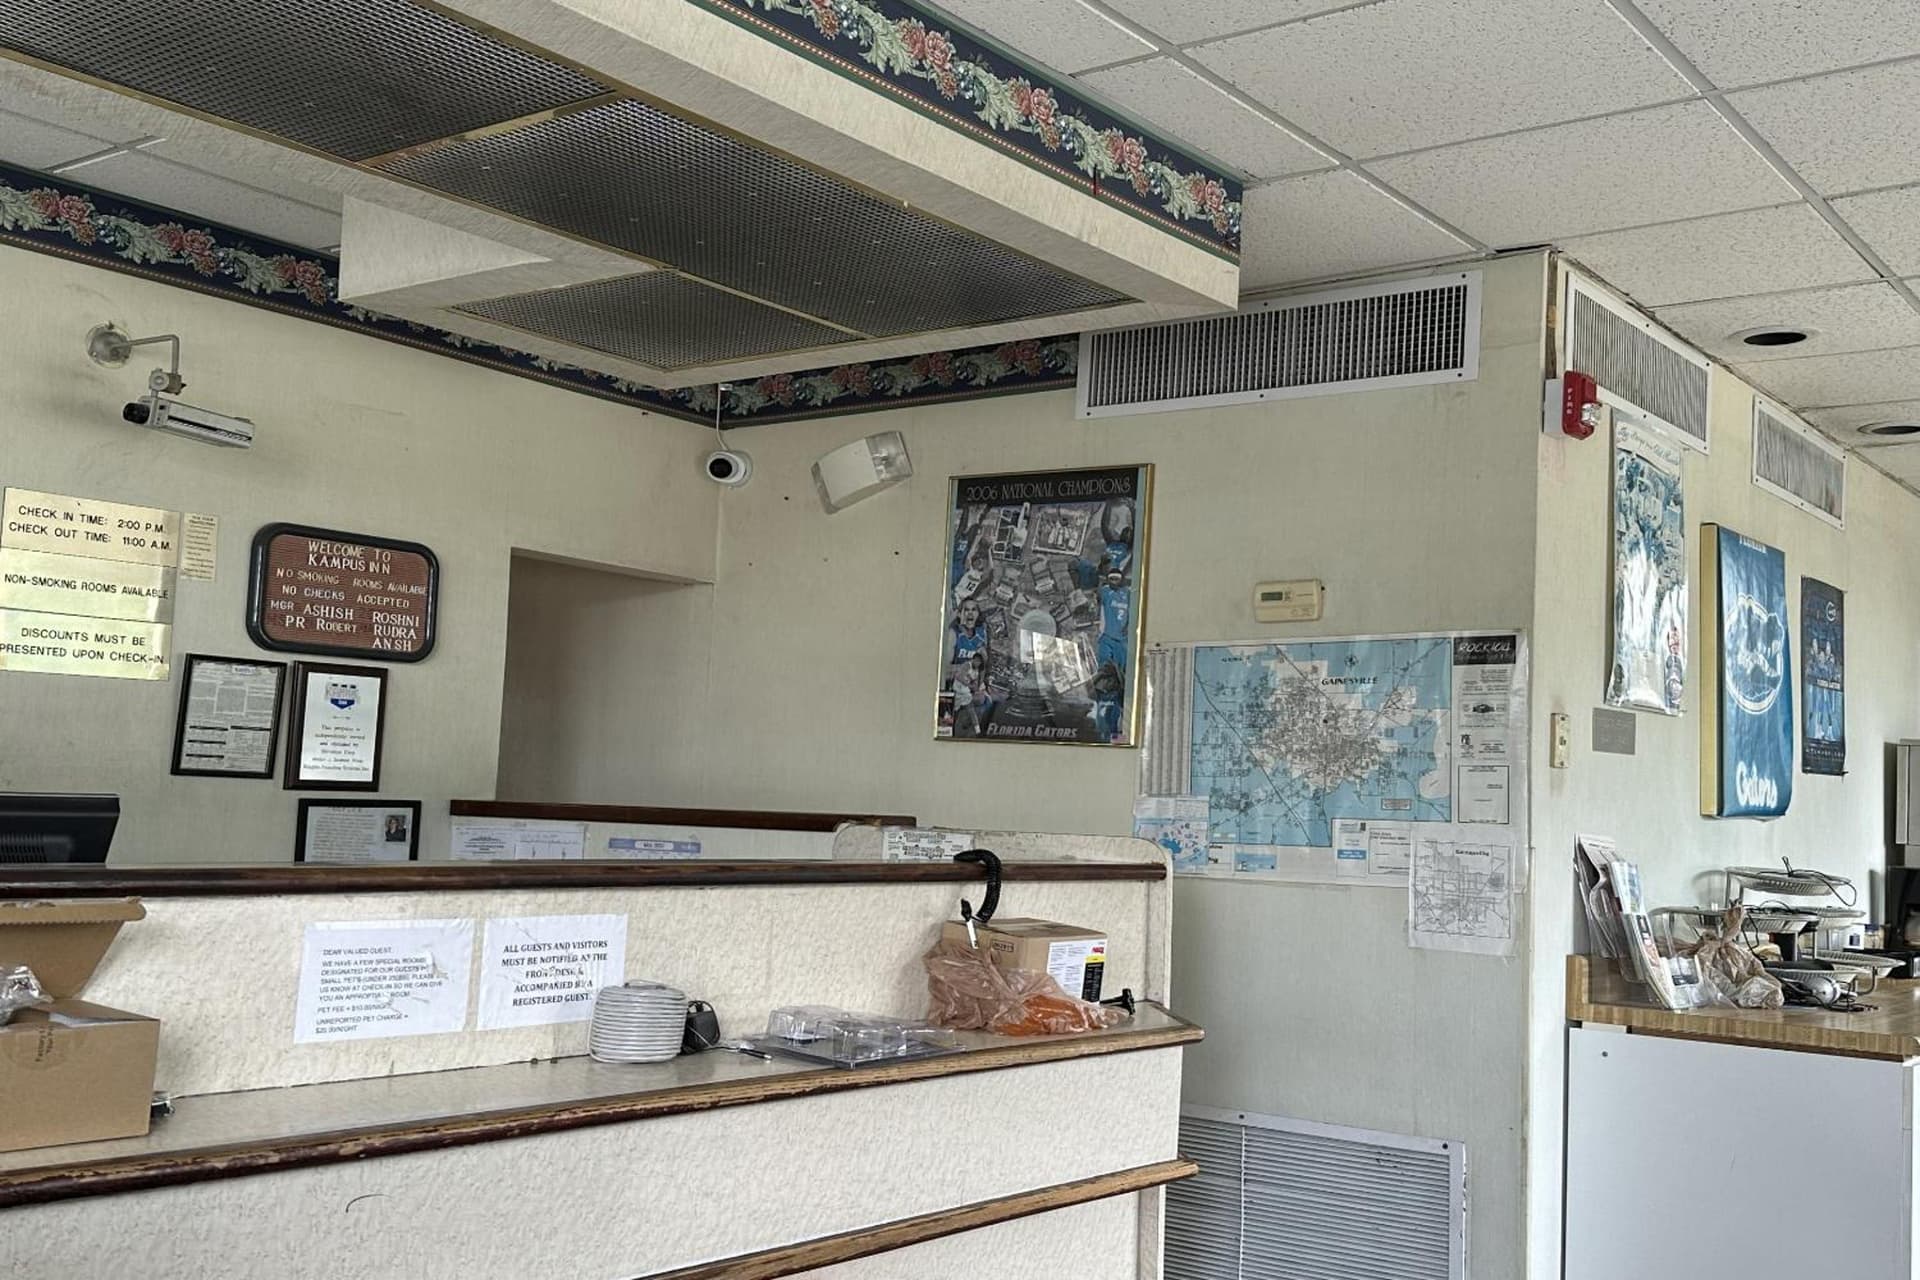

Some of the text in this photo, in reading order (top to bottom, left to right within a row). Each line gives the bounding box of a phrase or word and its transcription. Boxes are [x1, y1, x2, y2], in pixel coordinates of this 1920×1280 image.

[967, 476, 1131, 500] 2006 NATIONAL CHAMPIONS
[18, 505, 57, 519] CHECK
[63, 511, 74, 521] IN
[80, 514, 108, 526] TIME:
[117, 519, 141, 531] 2:00
[9, 521, 172, 551] CHECK OUT TIME: 11:00 A.M.
[308, 540, 392, 563] WELCOME TO
[308, 553, 391, 575] KAMPUS INN
[4, 573, 169, 600] NON-SMOKING ROOMS AVAILABLE
[276, 567, 294, 579] NO
[297, 569, 340, 585] SMOKING
[352, 577, 384, 590] ROOMS
[281, 584, 410, 609] NO CHECKS ACCEPTED
[270, 600, 420, 628] MGR ASHISH ROSHNI
[21, 627, 147, 646] DISCOUNTS MUST BE
[285, 614, 306, 630] PR
[373, 623, 417, 640] RUDRA
[0, 643, 165, 665] PRESENTED UPON CHECK-IN
[371, 637, 412, 652] ANSH
[987, 722, 1078, 738] FLORIDA GATORS
[503, 940, 608, 953] ALL GUESTS AND VISITORS
[501, 957, 526, 967] MUST
[526, 957, 538, 965] BE
[592, 953, 608, 961] THE
[514, 981, 574, 993] ACCOMPANIED
[512, 995, 563, 1007] REGISTERED
